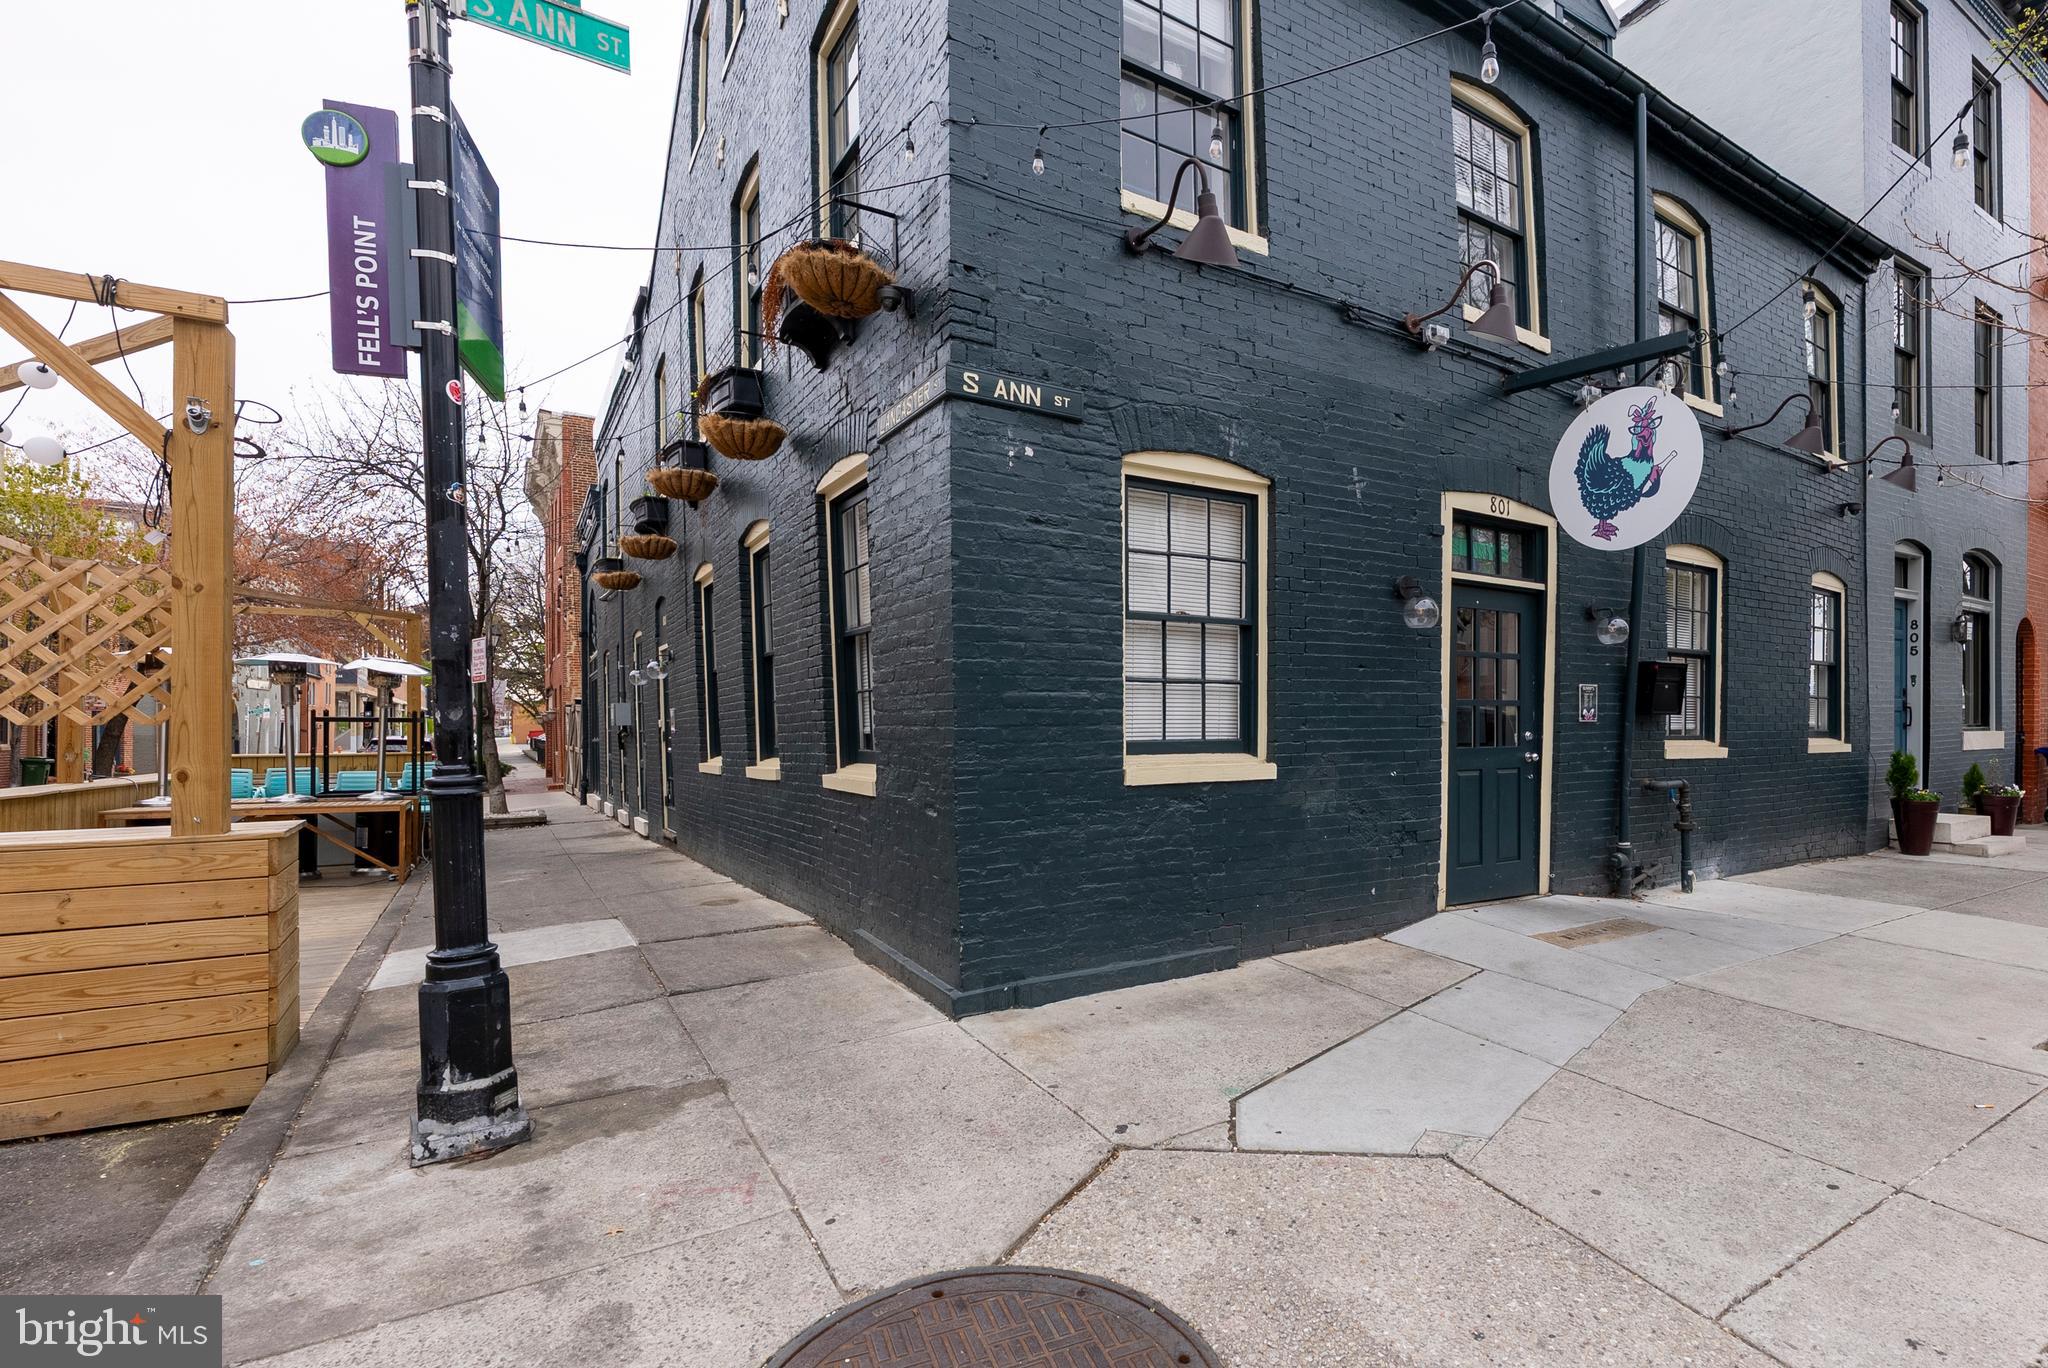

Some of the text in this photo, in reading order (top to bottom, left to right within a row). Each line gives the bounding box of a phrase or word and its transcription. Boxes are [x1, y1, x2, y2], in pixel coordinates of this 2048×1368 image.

[508, 0, 577, 47] ANN
[597, 32, 625, 58] ST.
[353, 215, 381, 366] FELL'S POINT
[879, 381, 931, 435] LANCASTER
[962, 371, 1071, 408] S ANN ST
[1490, 496, 1510, 517] 801
[1909, 619, 1919, 656] 805
